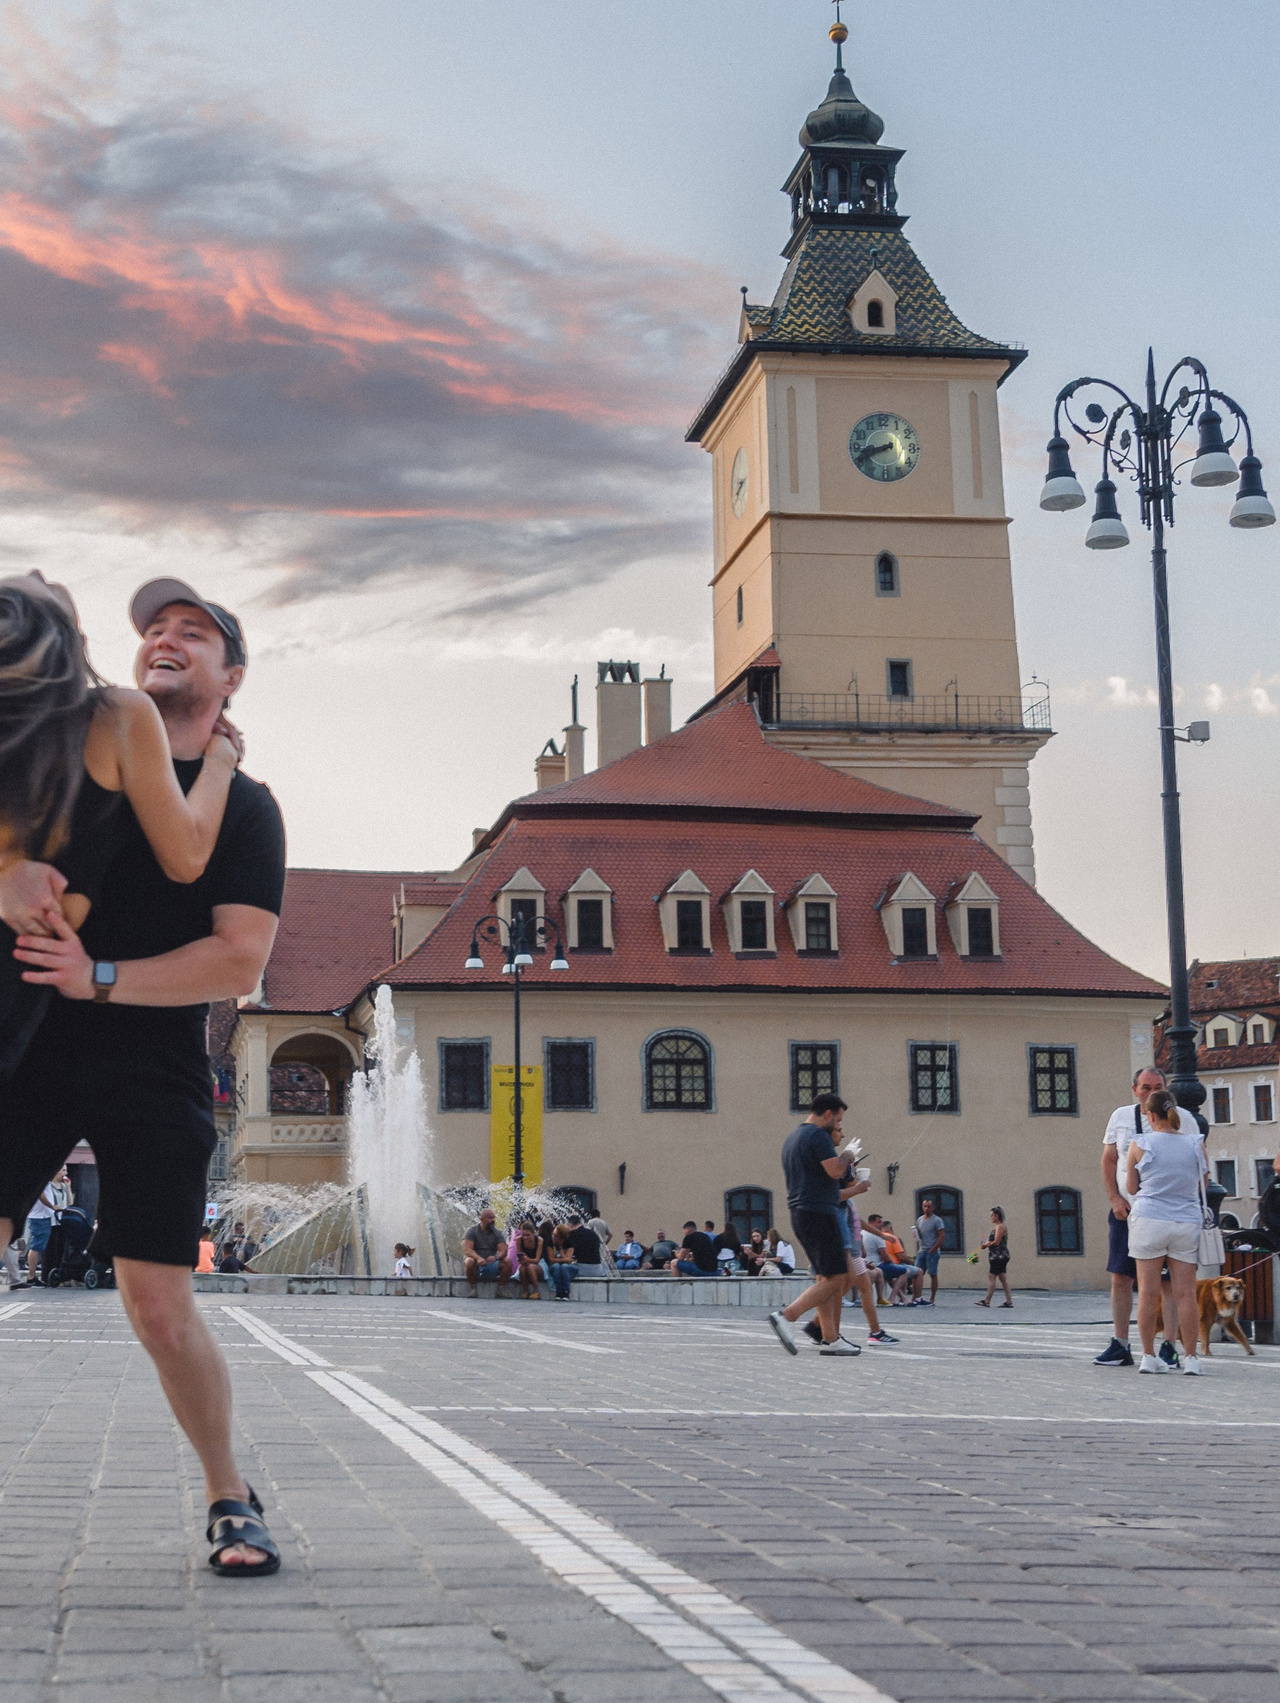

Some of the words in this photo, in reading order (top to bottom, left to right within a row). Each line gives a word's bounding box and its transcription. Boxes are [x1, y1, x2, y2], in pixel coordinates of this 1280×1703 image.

[866, 421, 875, 430] 11
[878, 416, 889, 427] 12
[894, 420, 899, 430] 1
[855, 430, 867, 440] 10
[904, 429, 911, 439] 2
[853, 442, 860, 452] 9
[909, 443, 916, 454] 3
[905, 457, 912, 467] 4
